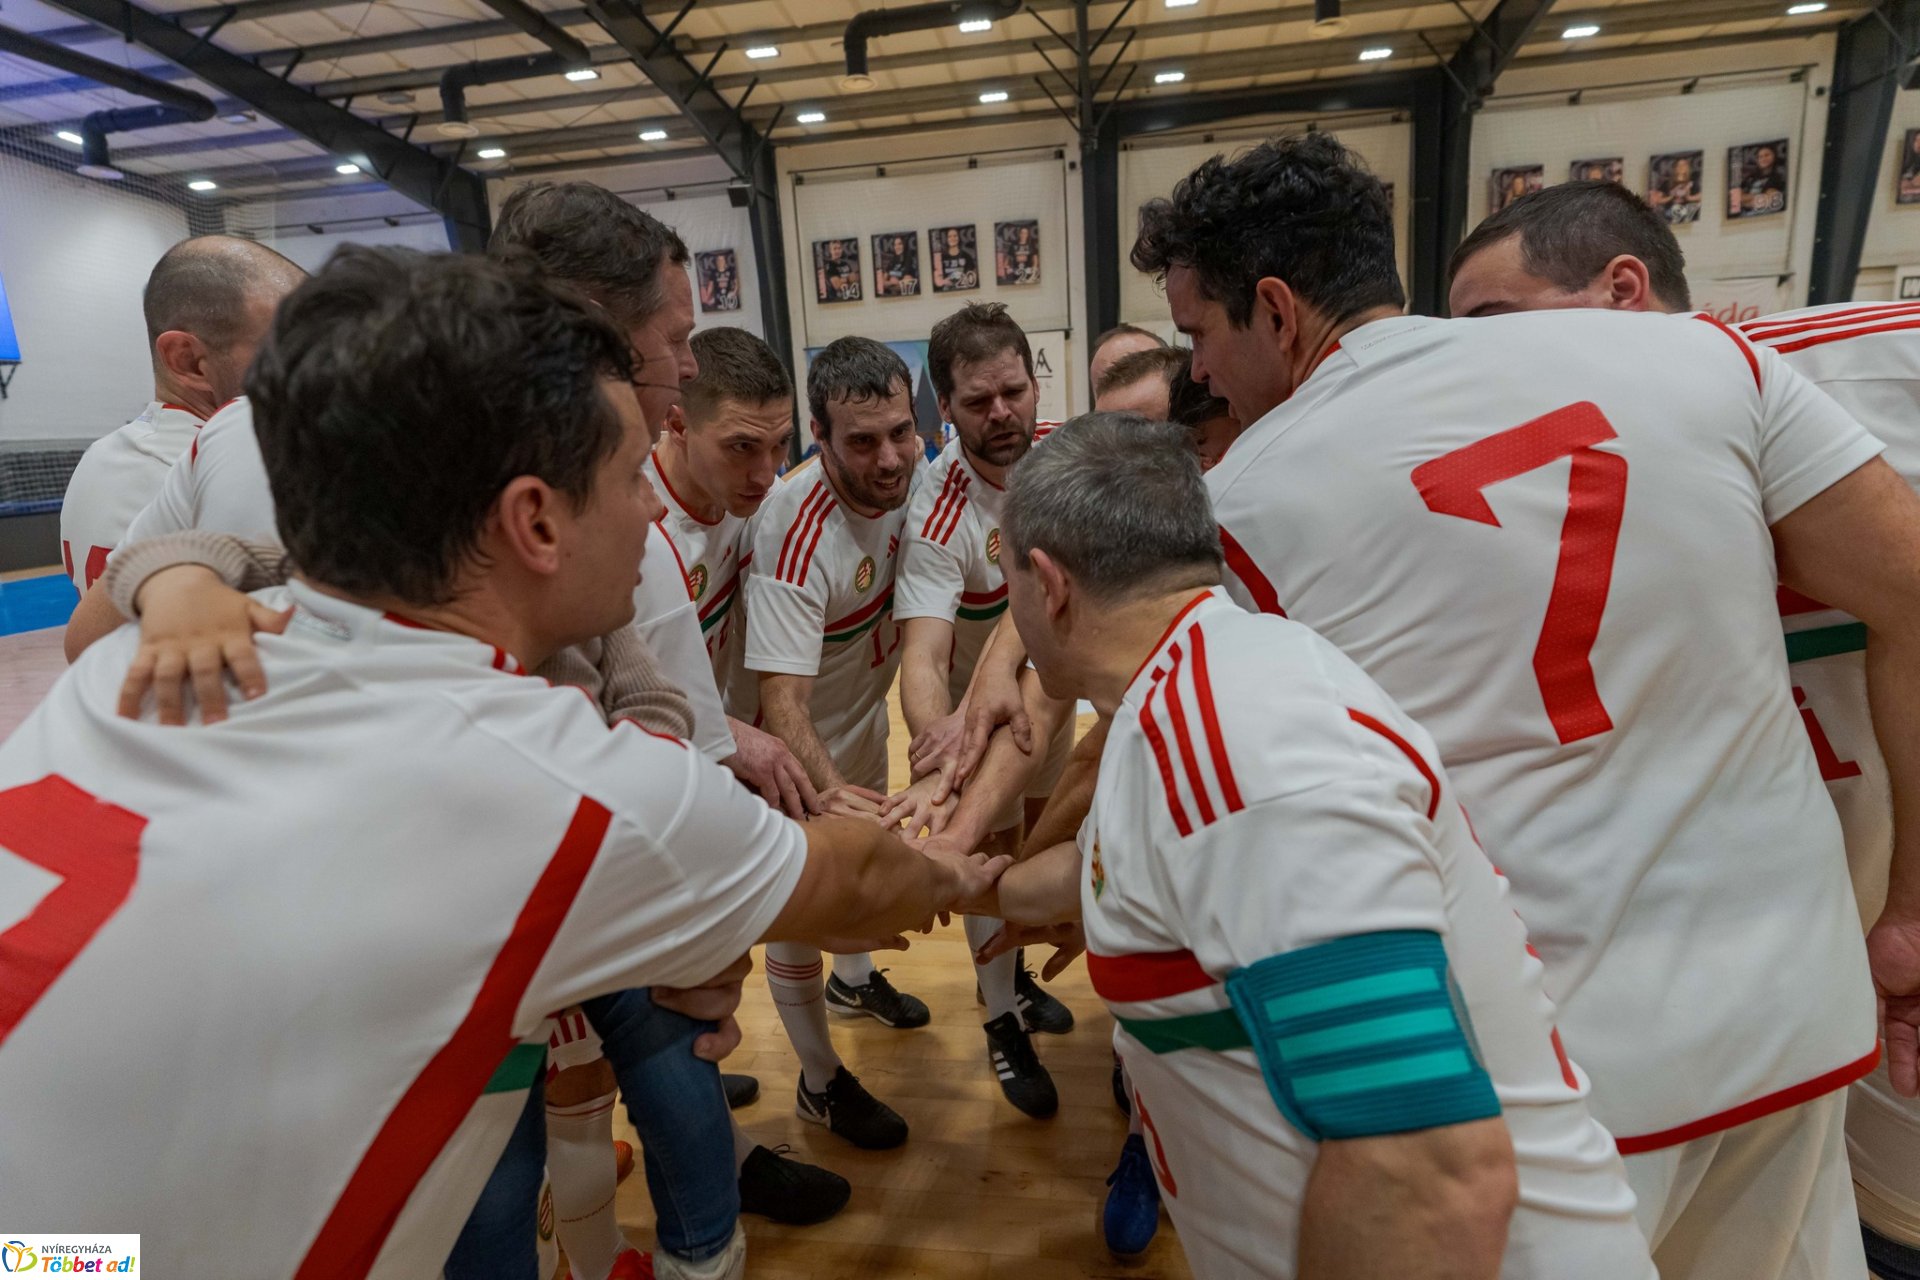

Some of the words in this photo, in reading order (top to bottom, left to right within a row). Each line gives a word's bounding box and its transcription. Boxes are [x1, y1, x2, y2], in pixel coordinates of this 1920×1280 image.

[898, 278, 918, 296] 17
[955, 271, 977, 288] 20
[840, 282, 860, 300] 14
[1411, 401, 1628, 744] 7
